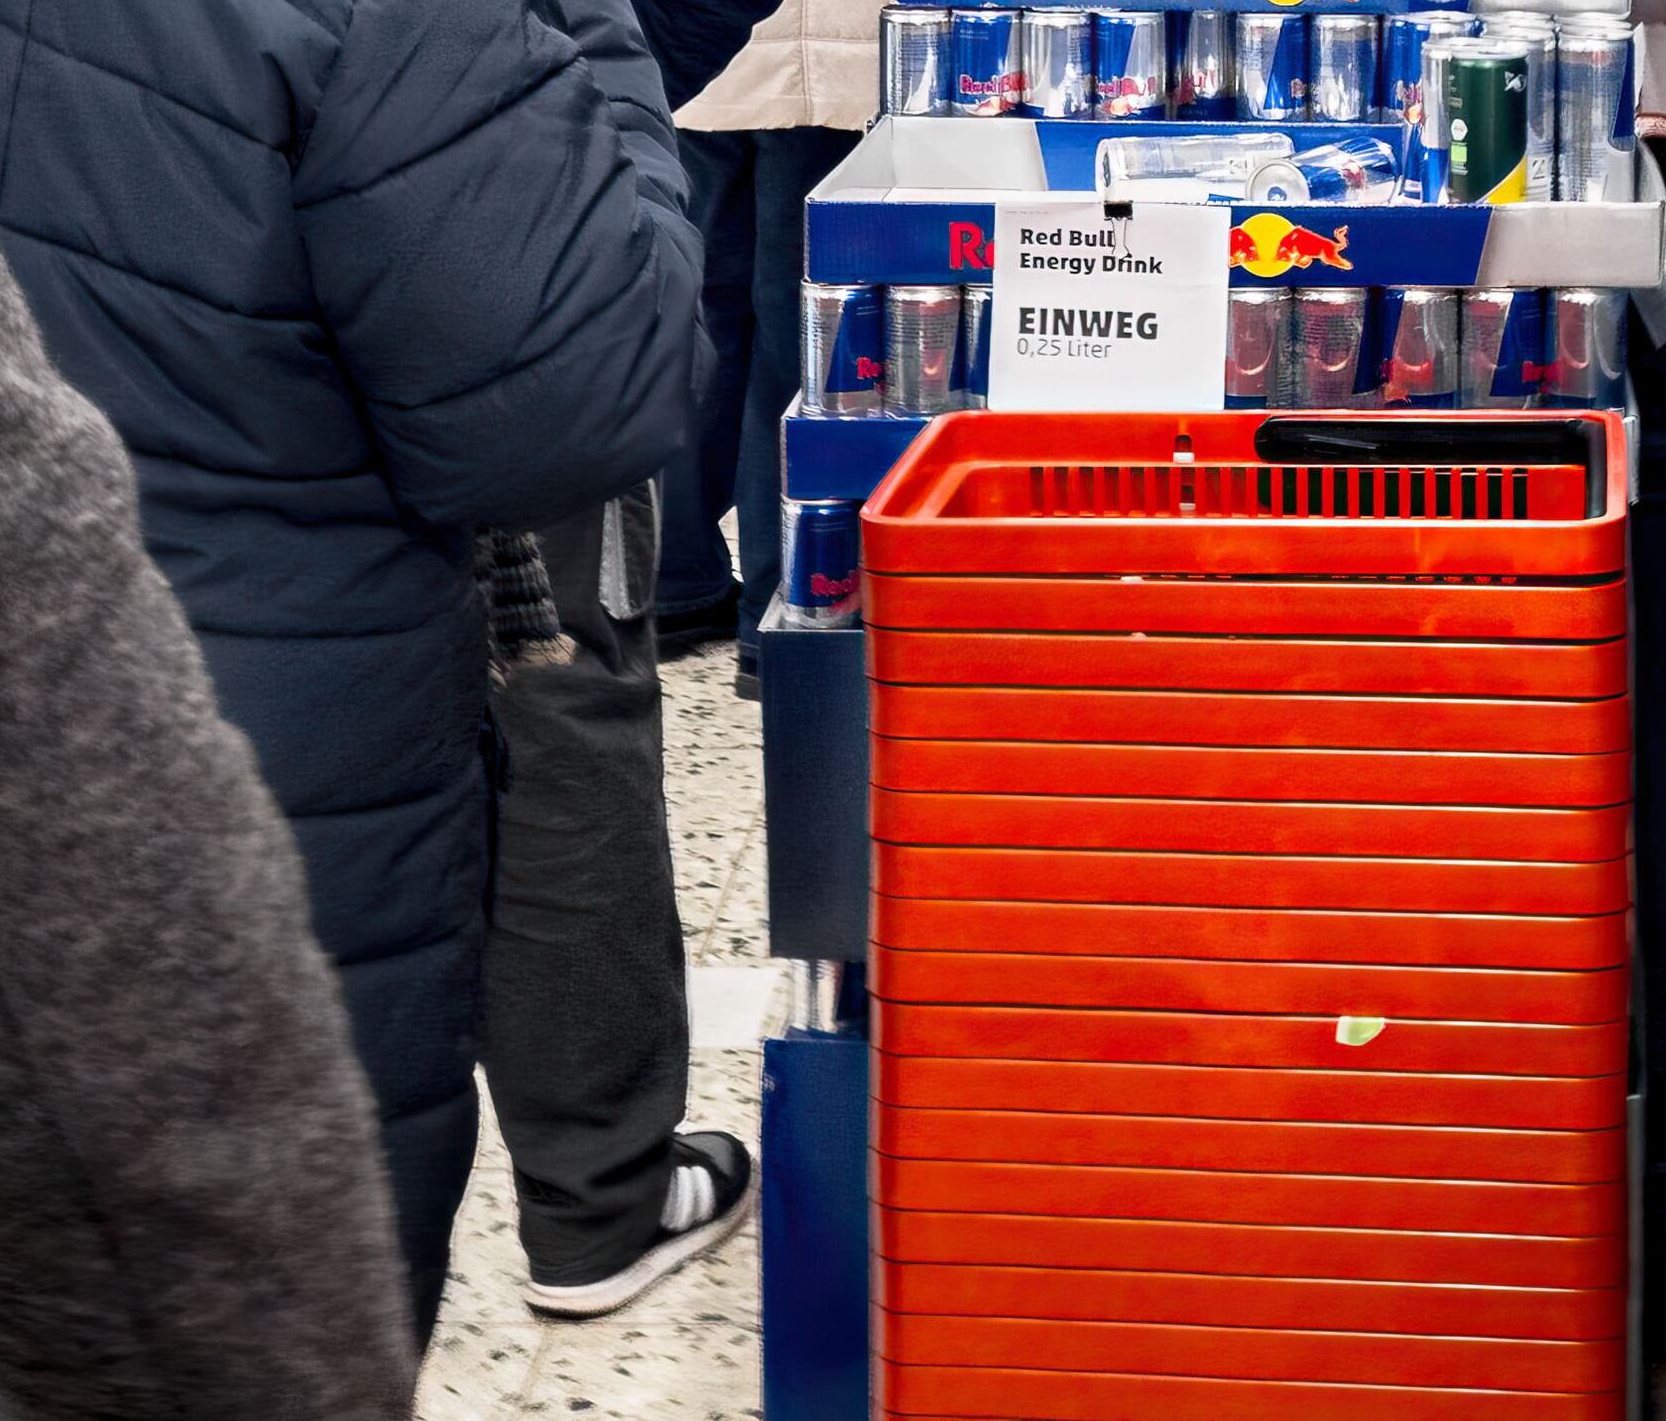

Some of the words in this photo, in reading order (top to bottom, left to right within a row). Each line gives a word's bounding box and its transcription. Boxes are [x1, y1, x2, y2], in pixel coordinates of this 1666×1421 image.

[1020, 228, 1062, 246] Red
[1069, 229, 1116, 248] Bull
[1020, 253, 1096, 275] Energy
[1102, 255, 1163, 275] Drink
[1019, 307, 1159, 340] EINWEG
[1016, 338, 1062, 358] 0,25
[1068, 339, 1113, 359] Liter
